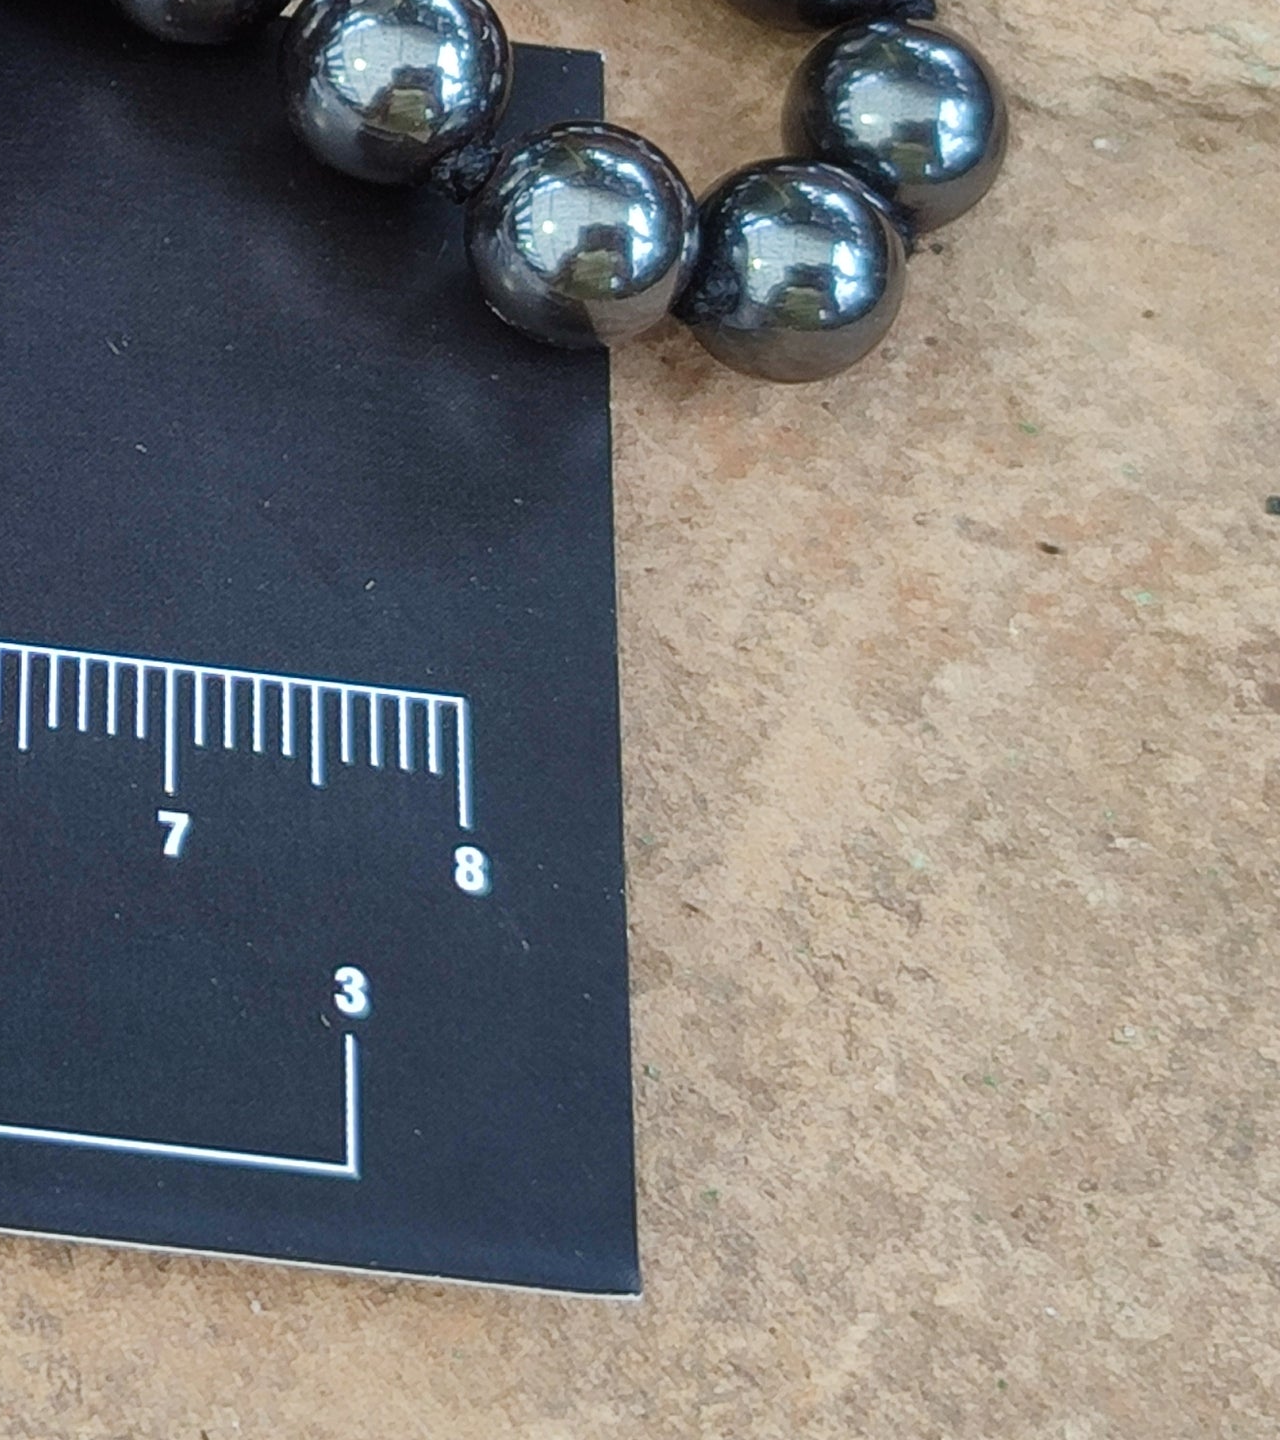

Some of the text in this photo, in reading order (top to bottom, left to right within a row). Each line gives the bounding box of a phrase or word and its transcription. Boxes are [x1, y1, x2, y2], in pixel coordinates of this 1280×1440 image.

[156, 808, 191, 859] 7
[453, 844, 490, 896] 8
[332, 965, 371, 1018] 3
